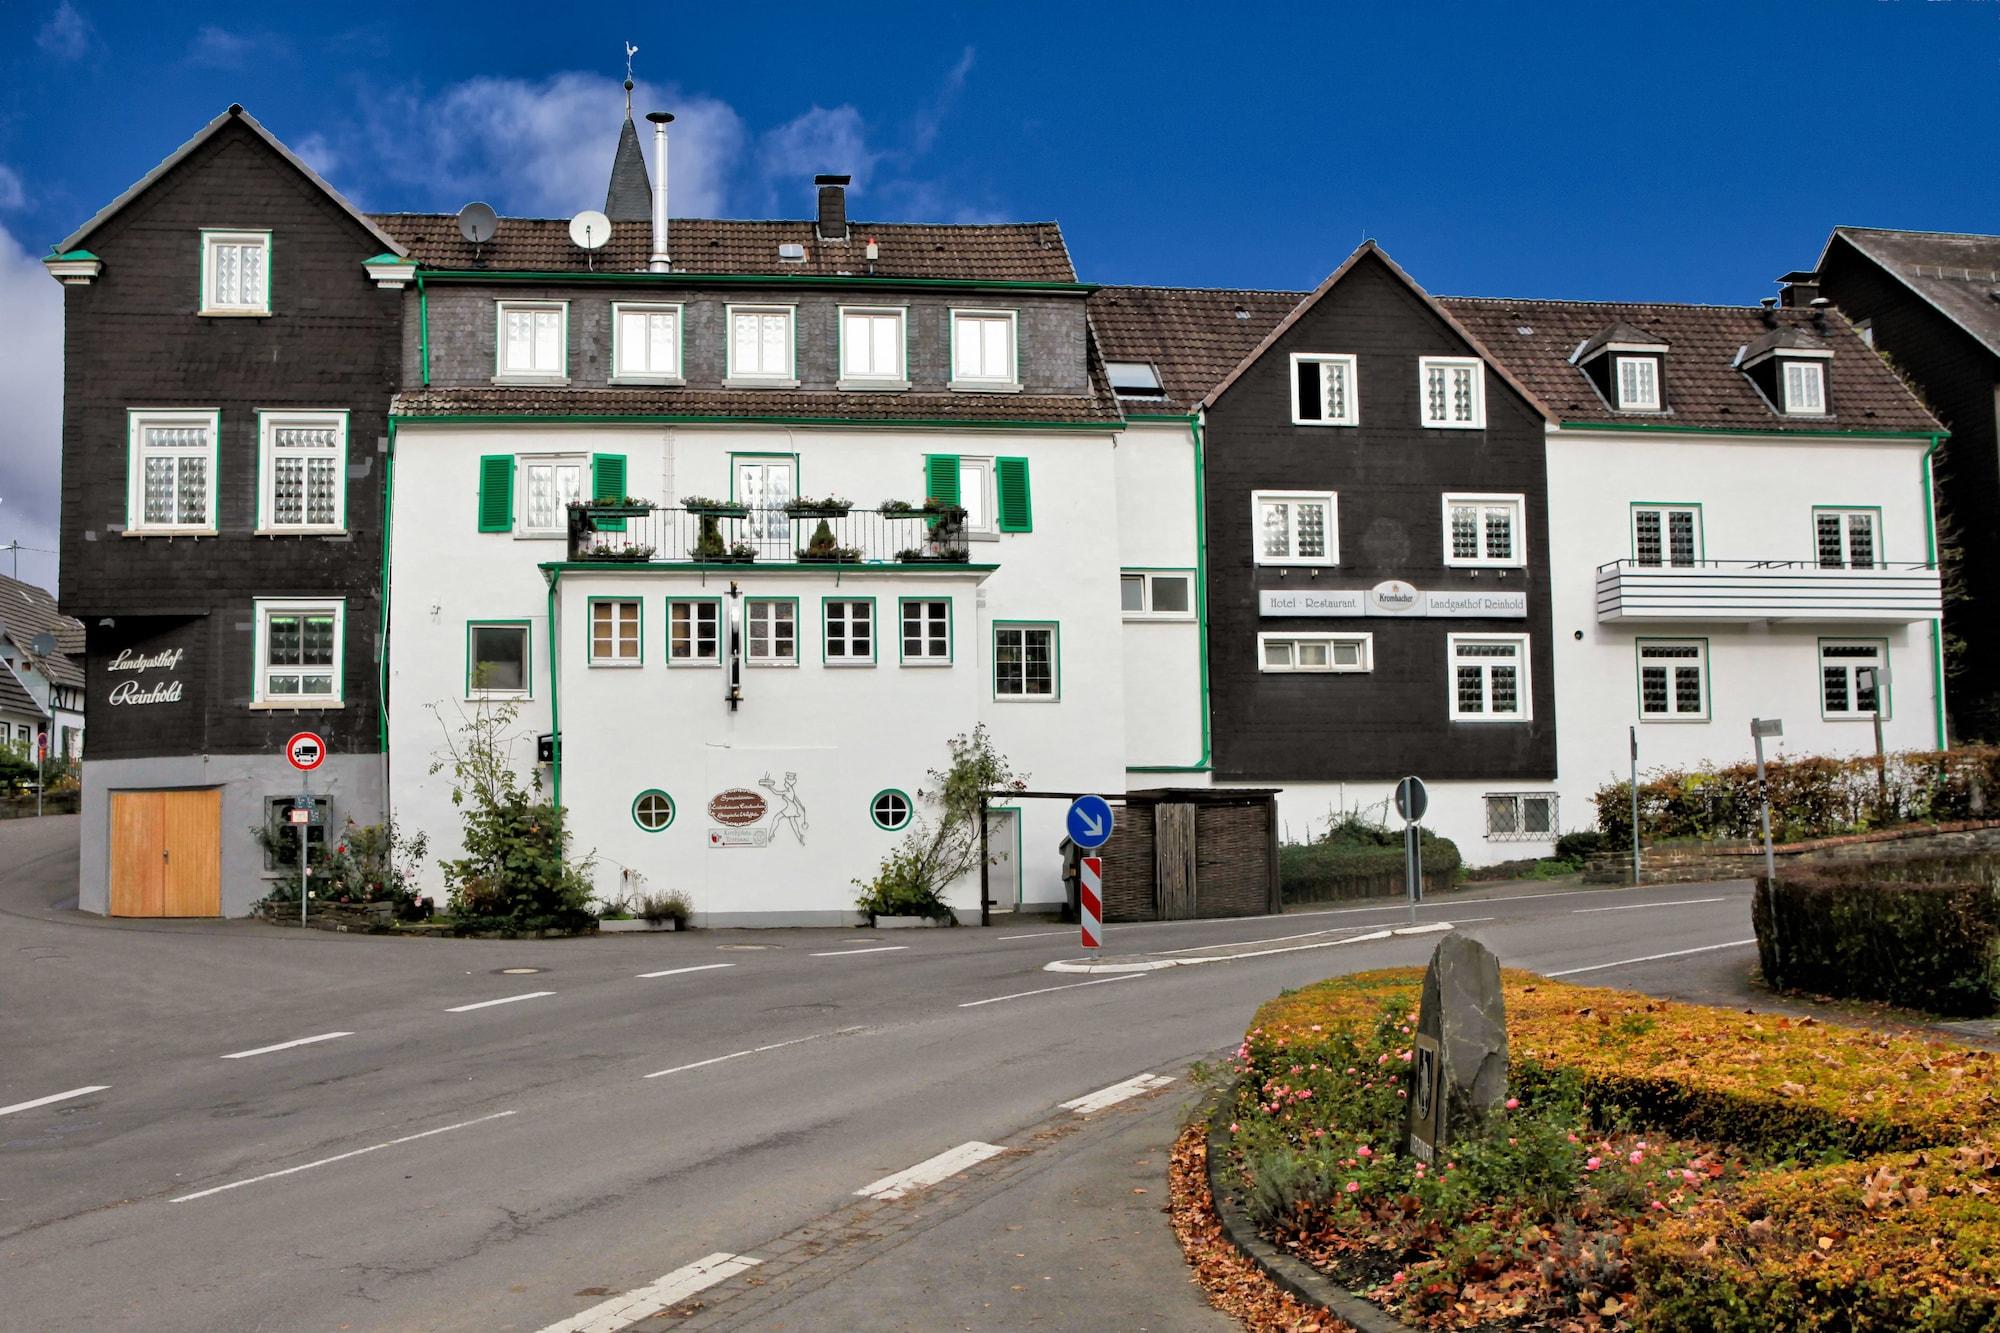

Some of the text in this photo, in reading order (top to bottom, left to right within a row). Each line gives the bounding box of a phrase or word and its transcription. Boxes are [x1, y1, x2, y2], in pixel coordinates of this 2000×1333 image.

[1270, 598, 1357, 608] Hotel Restaurant
[1379, 593, 1413, 603] Krombacher
[1430, 598, 1524, 613] Landgasthof Reinhold
[107, 648, 183, 673] Landgasthof
[109, 680, 183, 706] Reinhold
